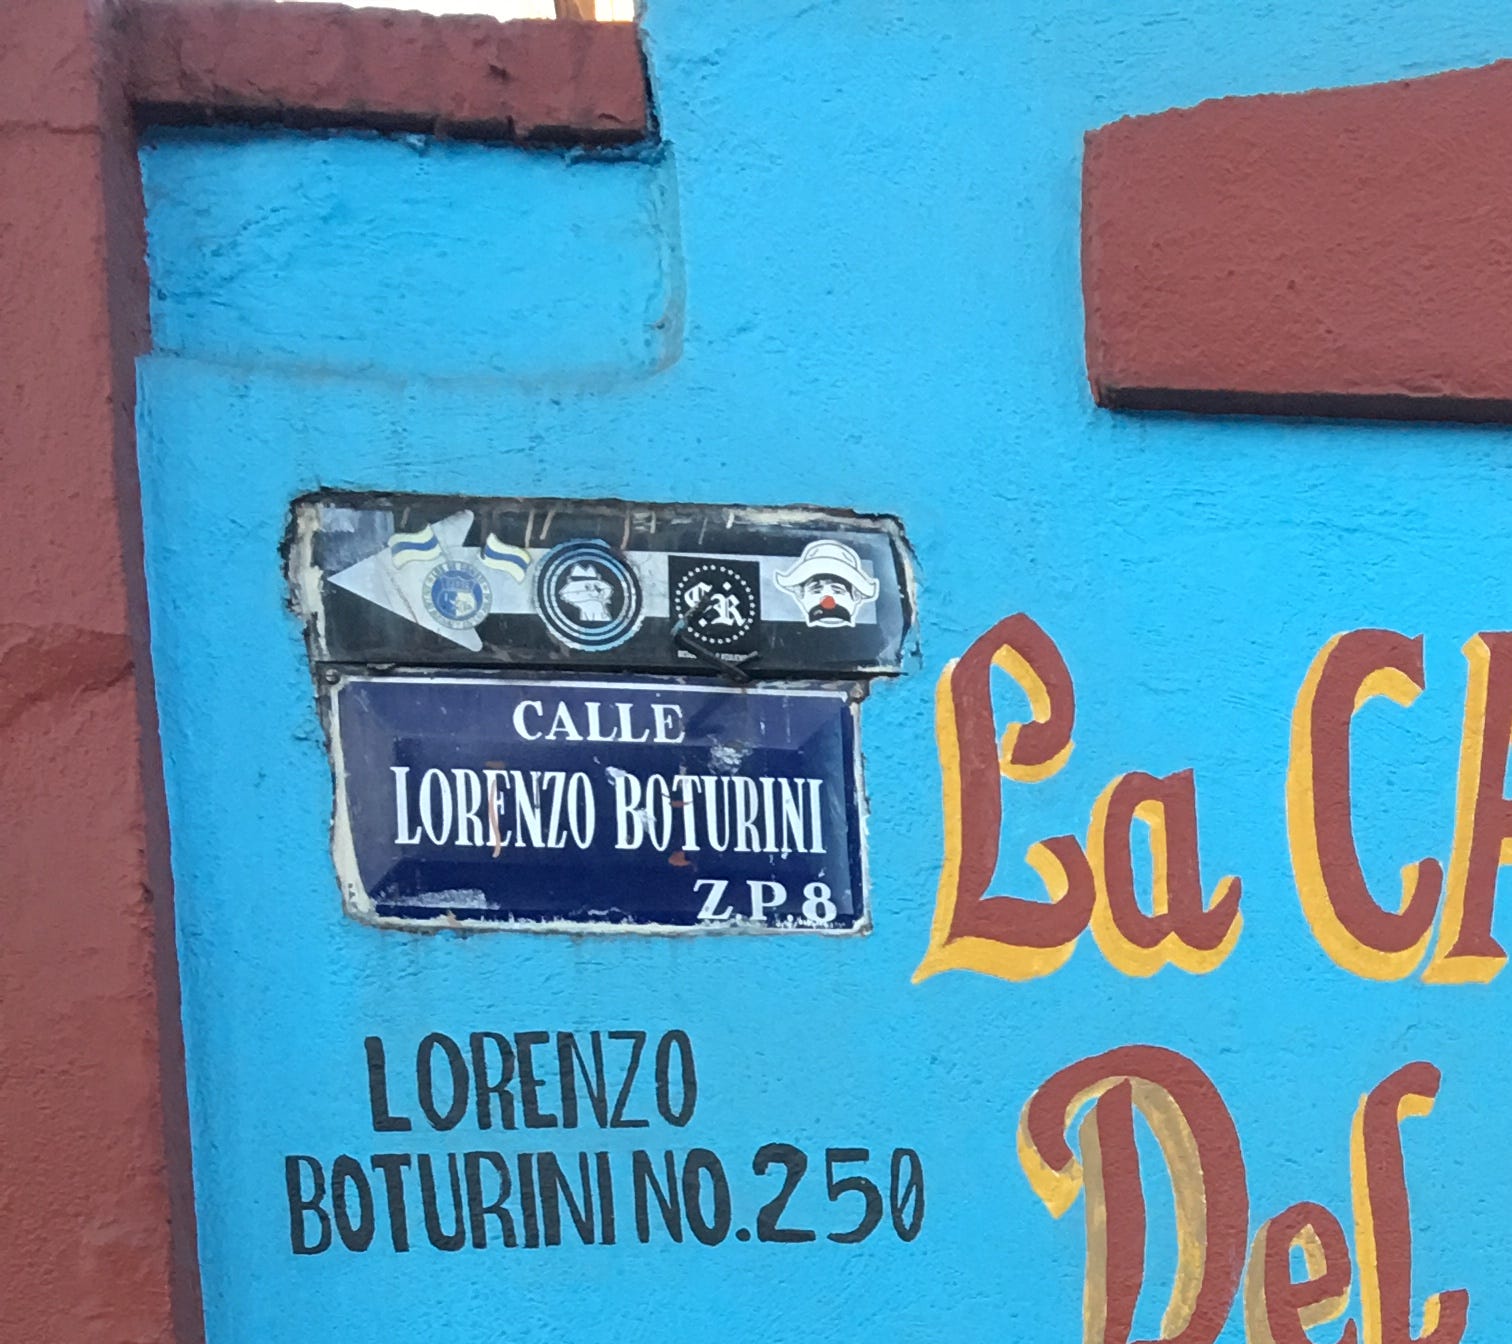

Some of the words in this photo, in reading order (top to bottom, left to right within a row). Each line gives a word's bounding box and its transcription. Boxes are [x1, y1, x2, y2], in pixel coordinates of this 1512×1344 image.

[513, 698, 685, 744] CALLE
[389, 765, 596, 851] LORENZO
[613, 771, 827, 855] BOTURINI
[912, 612, 1243, 983] La
[364, 1028, 697, 1133] LORENZO
[284, 1149, 617, 1255] BOTURINI
